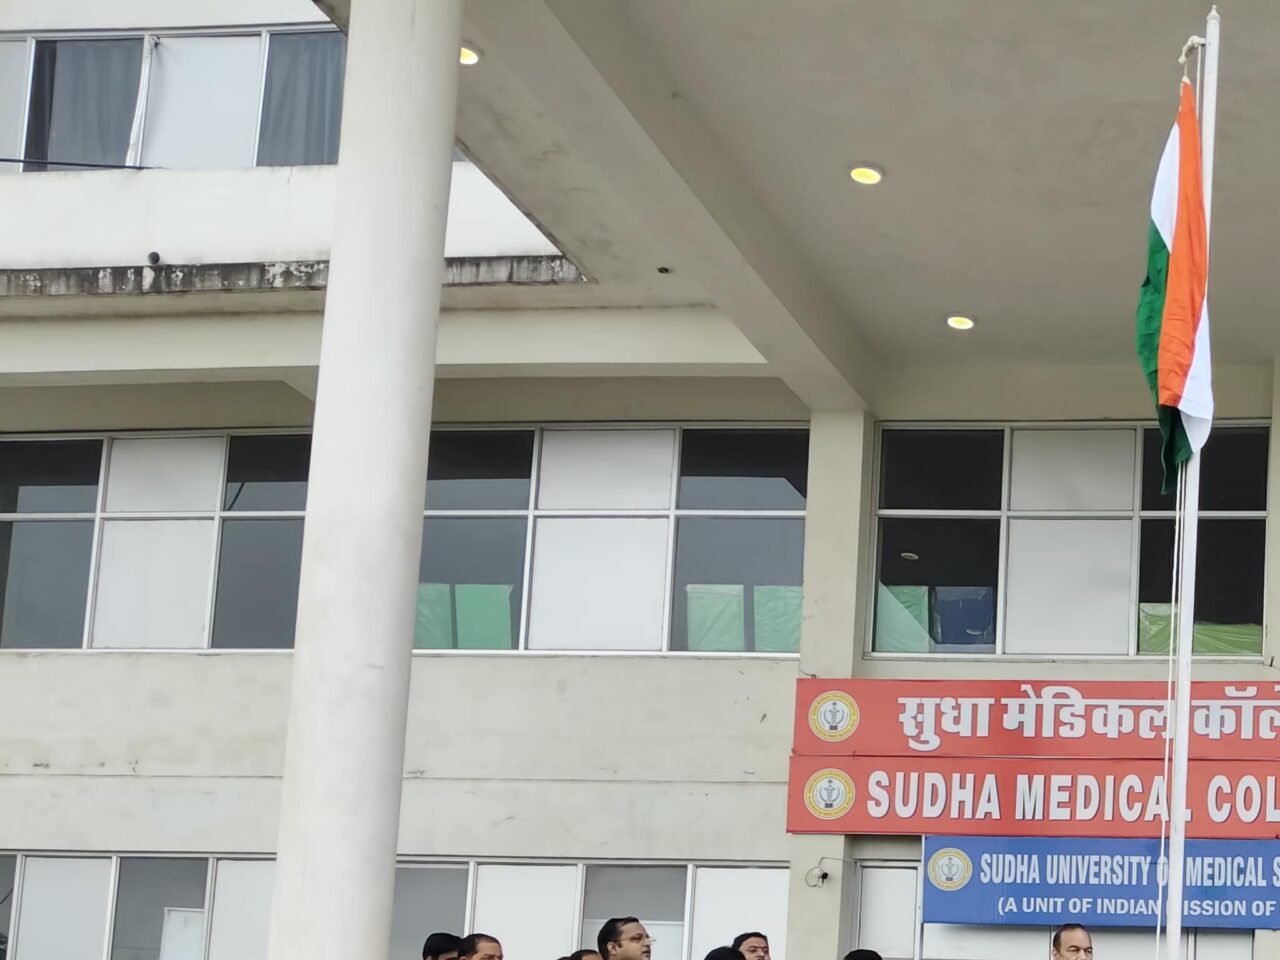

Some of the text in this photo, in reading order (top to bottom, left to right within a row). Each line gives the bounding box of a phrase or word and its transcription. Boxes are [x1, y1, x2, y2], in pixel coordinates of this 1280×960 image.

[897, 697, 995, 751] सुधा
[1000, 684, 1177, 740] मेडिकल
[866, 770, 1001, 820] SUDHA
[1014, 774, 1192, 823] MEDICA
[980, 853, 1041, 884] SUDHA
[1046, 854, 1152, 887] UNIVERSITY
[1185, 856, 1267, 888] MEDICAL
[997, 897, 1018, 916] (A
[1022, 897, 1065, 914] UNIT
[1069, 898, 1093, 914] OF
[1097, 898, 1160, 915] INDIAN
[1166, 900, 1247, 917] ISSION
[1251, 900, 1276, 917] OF
